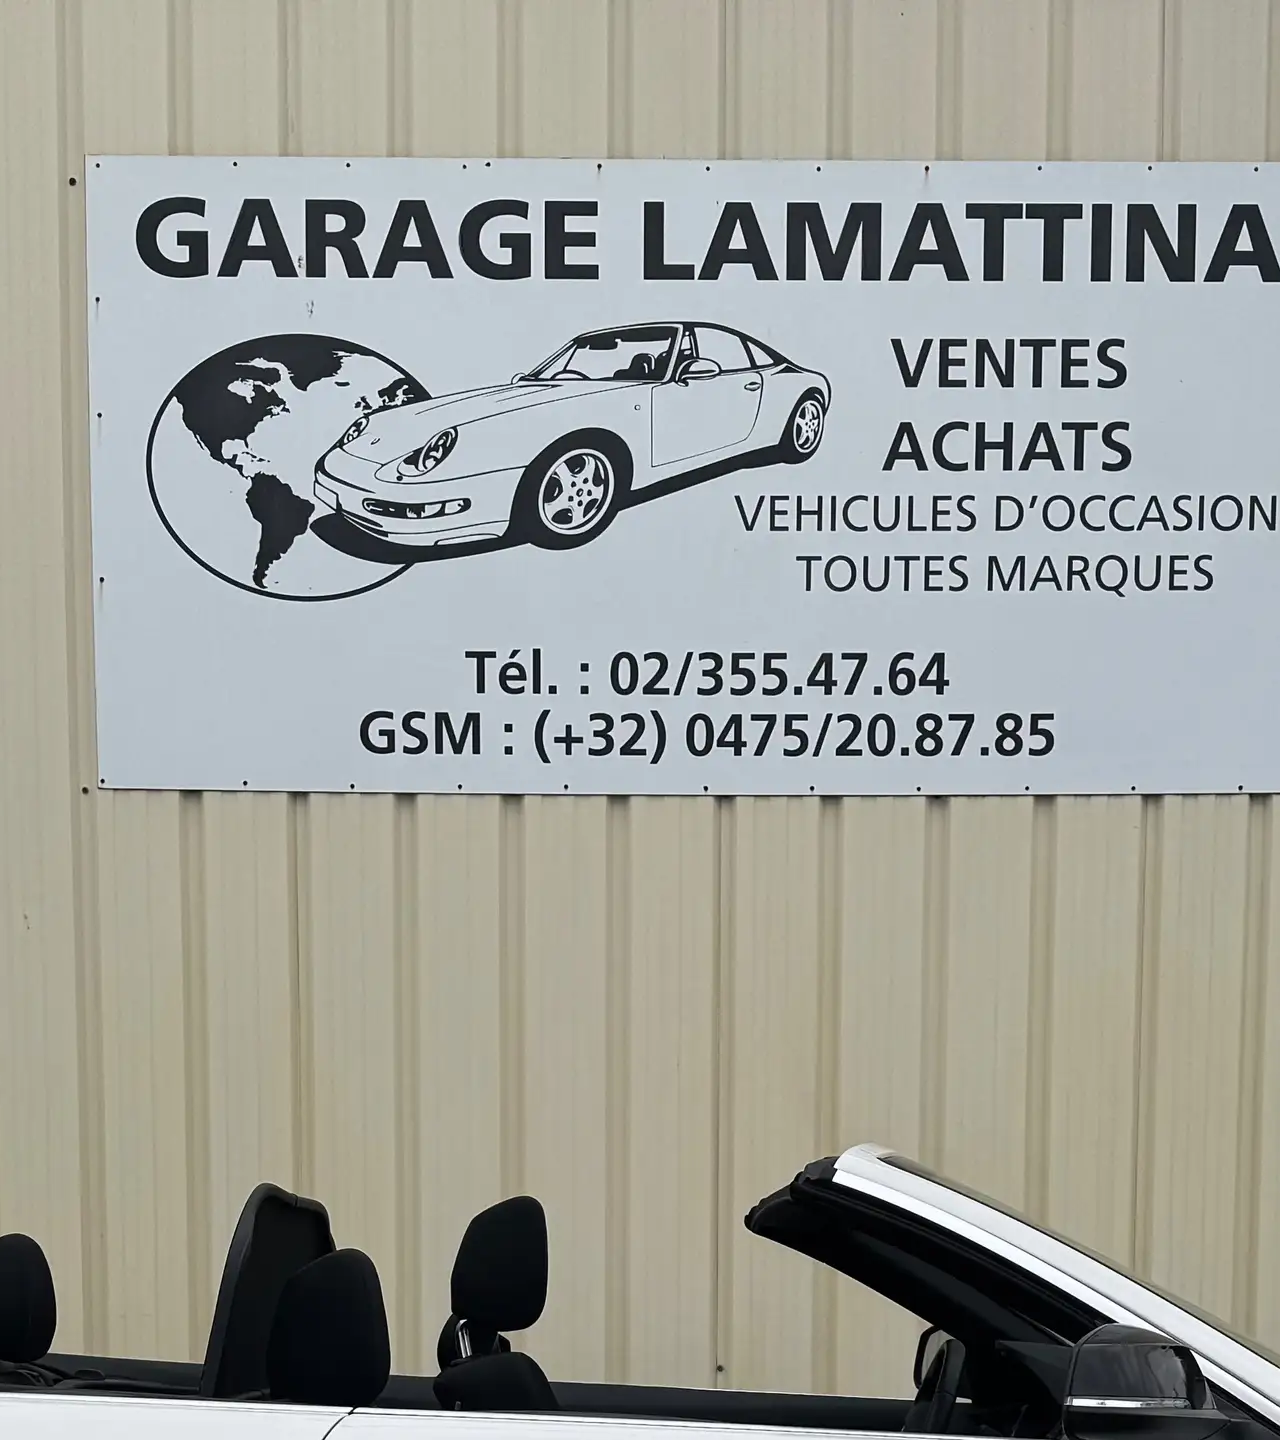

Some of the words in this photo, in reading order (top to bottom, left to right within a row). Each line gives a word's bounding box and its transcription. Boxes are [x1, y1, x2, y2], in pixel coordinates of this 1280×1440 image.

[135, 196, 600, 281] GARAGE
[890, 338, 1128, 389] VENTES
[881, 421, 1132, 472] ACHATS
[733, 494, 977, 532] VEHICULES
[795, 554, 969, 593] TOUTES
[987, 554, 1214, 598] MARQUES
[464, 648, 558, 695] Tél.
[610, 651, 950, 697] 02/355.47.64
[359, 710, 481, 755] GSM
[534, 709, 667, 765] (+32)
[685, 712, 1055, 758] 0475/20.87.85
